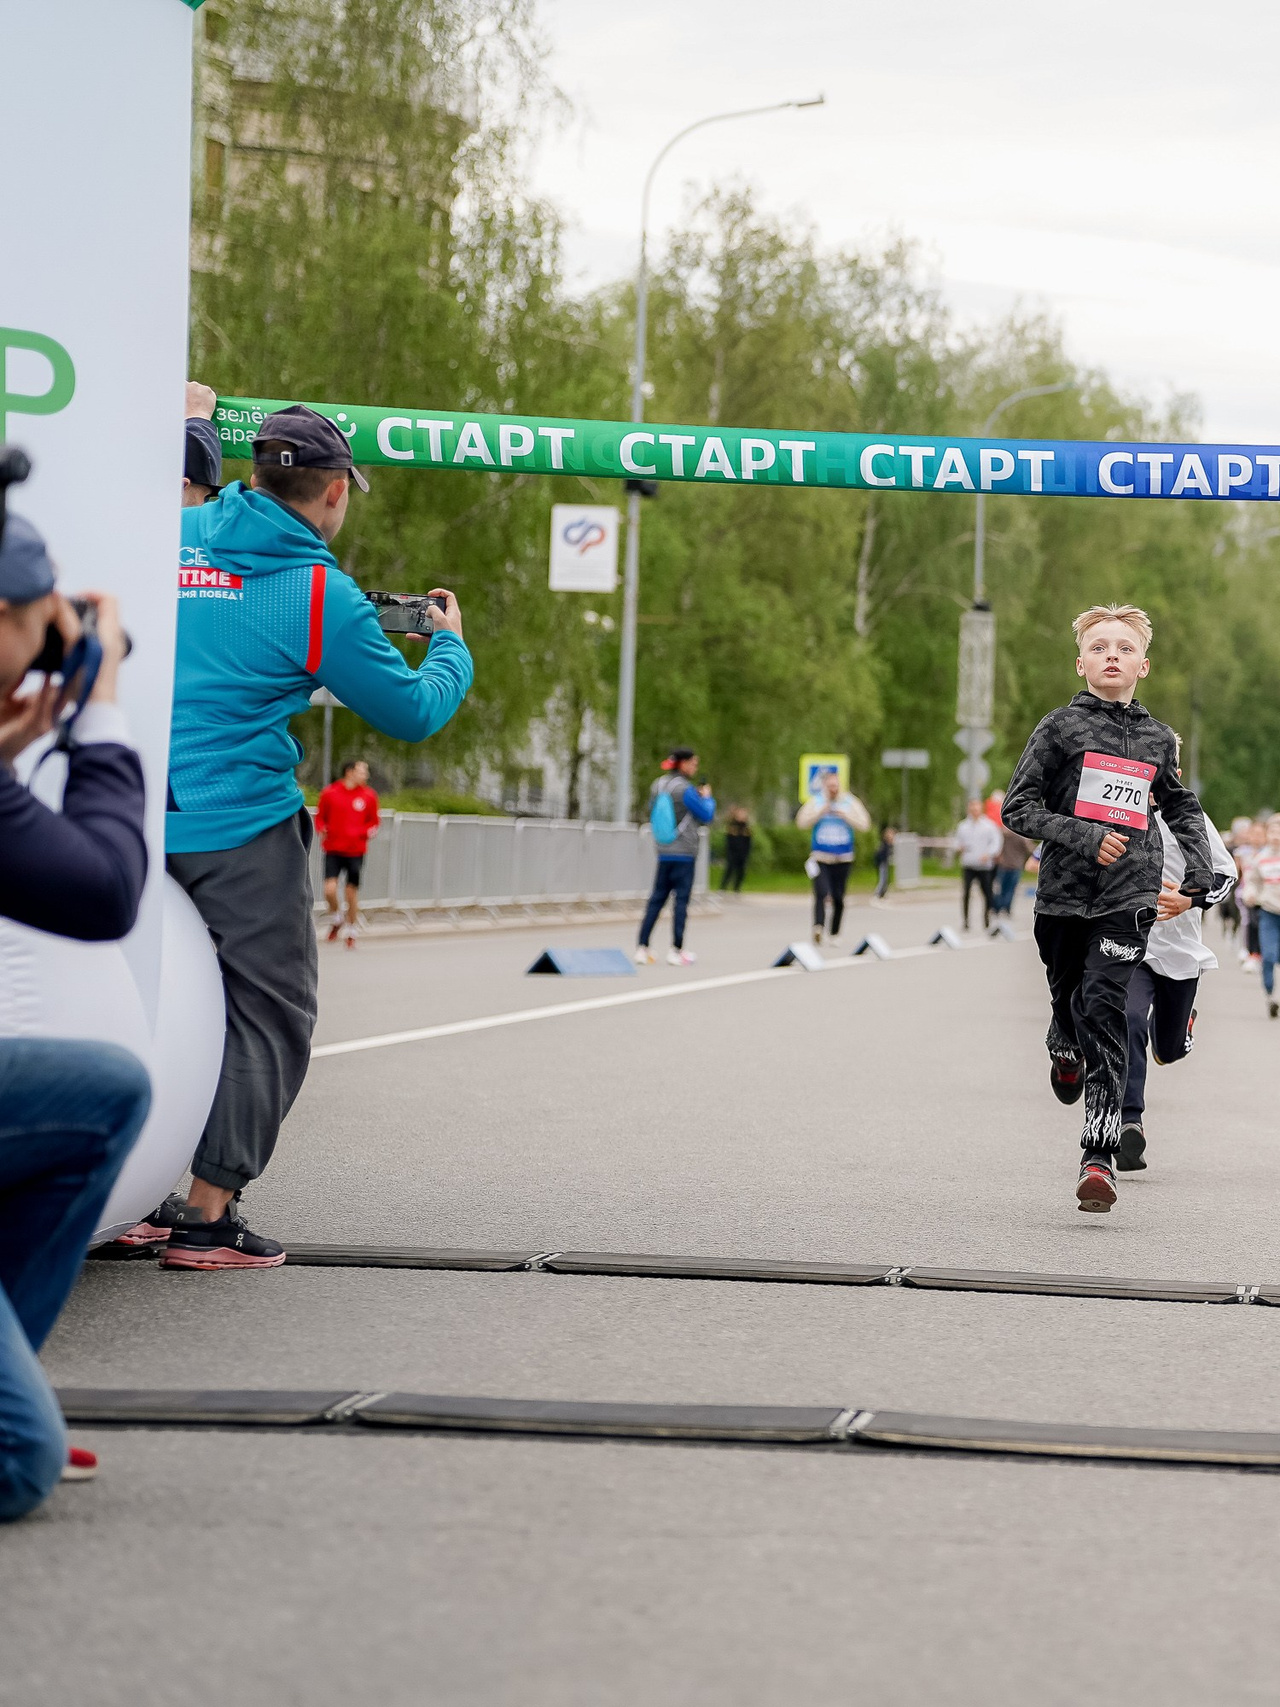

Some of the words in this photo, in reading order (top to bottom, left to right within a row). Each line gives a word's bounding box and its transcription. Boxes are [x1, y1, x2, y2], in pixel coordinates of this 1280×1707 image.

[376, 416, 575, 470] СТАРТ
[618, 432, 816, 483] СТАРТ
[859, 443, 1055, 492] СТАРТ
[178, 569, 231, 586] TIME
[1102, 783, 1142, 806] 2770
